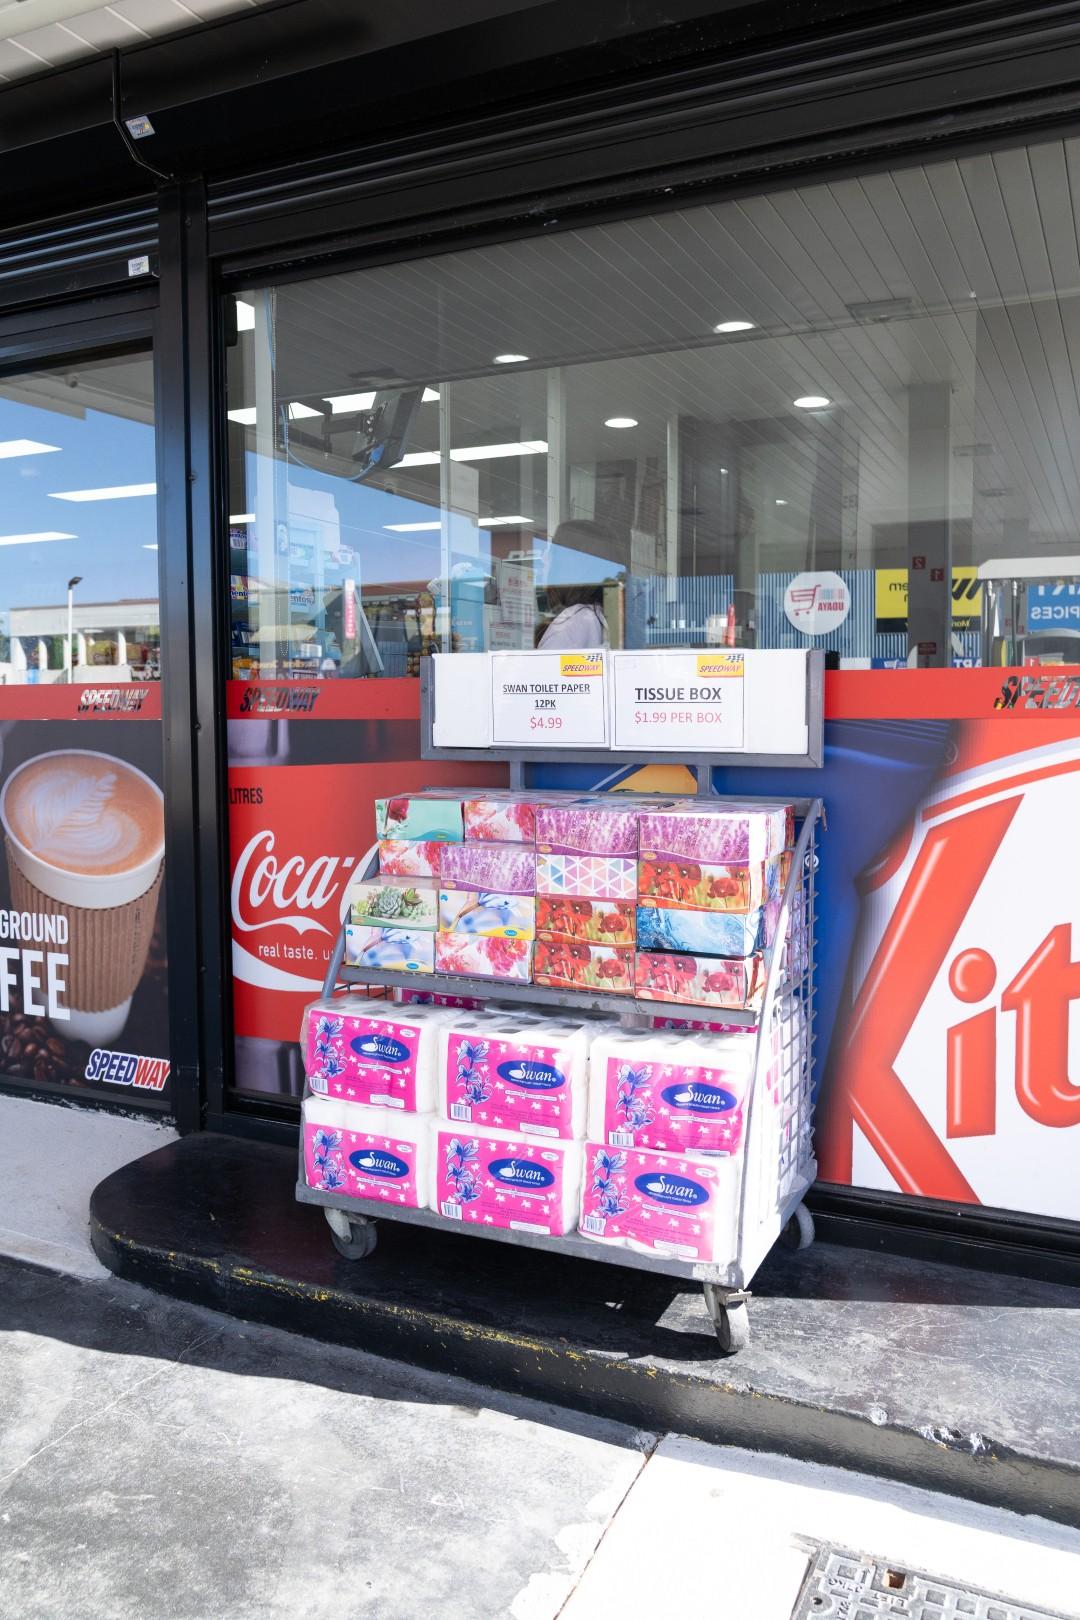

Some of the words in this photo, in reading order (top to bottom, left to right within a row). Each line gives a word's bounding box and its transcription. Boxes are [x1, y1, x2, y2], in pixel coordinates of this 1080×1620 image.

[563, 664, 599, 672] SPEEDWAY
[700, 664, 741, 672] SPEEDWAY
[503, 683, 528, 693] SWAN
[530, 683, 559, 693] TOILET
[561, 683, 590, 693] PAPER
[635, 687, 684, 701] TISSUE
[690, 687, 722, 701] BOX
[78, 689, 149, 712] SPEEDWAY
[240, 687, 320, 712] SPEEDWAY
[535, 699, 556, 709] 12PK
[530, 717, 562, 730] $4.99
[634, 711, 667, 724] $1.99
[671, 711, 693, 723] PER
[697, 711, 722, 723] BOX
[229, 787, 264, 805] LITRES
[0, 909, 69, 945] GROUND
[258, 944, 280, 958] real
[284, 945, 318, 961] taste.
[0, 947, 71, 1021] FEE
[361, 1037, 398, 1056] Swan
[86, 1050, 170, 1090] SPEEDWAY
[509, 1063, 552, 1082] Swan
[674, 1085, 721, 1105] Swan
[359, 1152, 397, 1171] Swan
[499, 1161, 542, 1181] Swan
[646, 1176, 694, 1198] Swan
